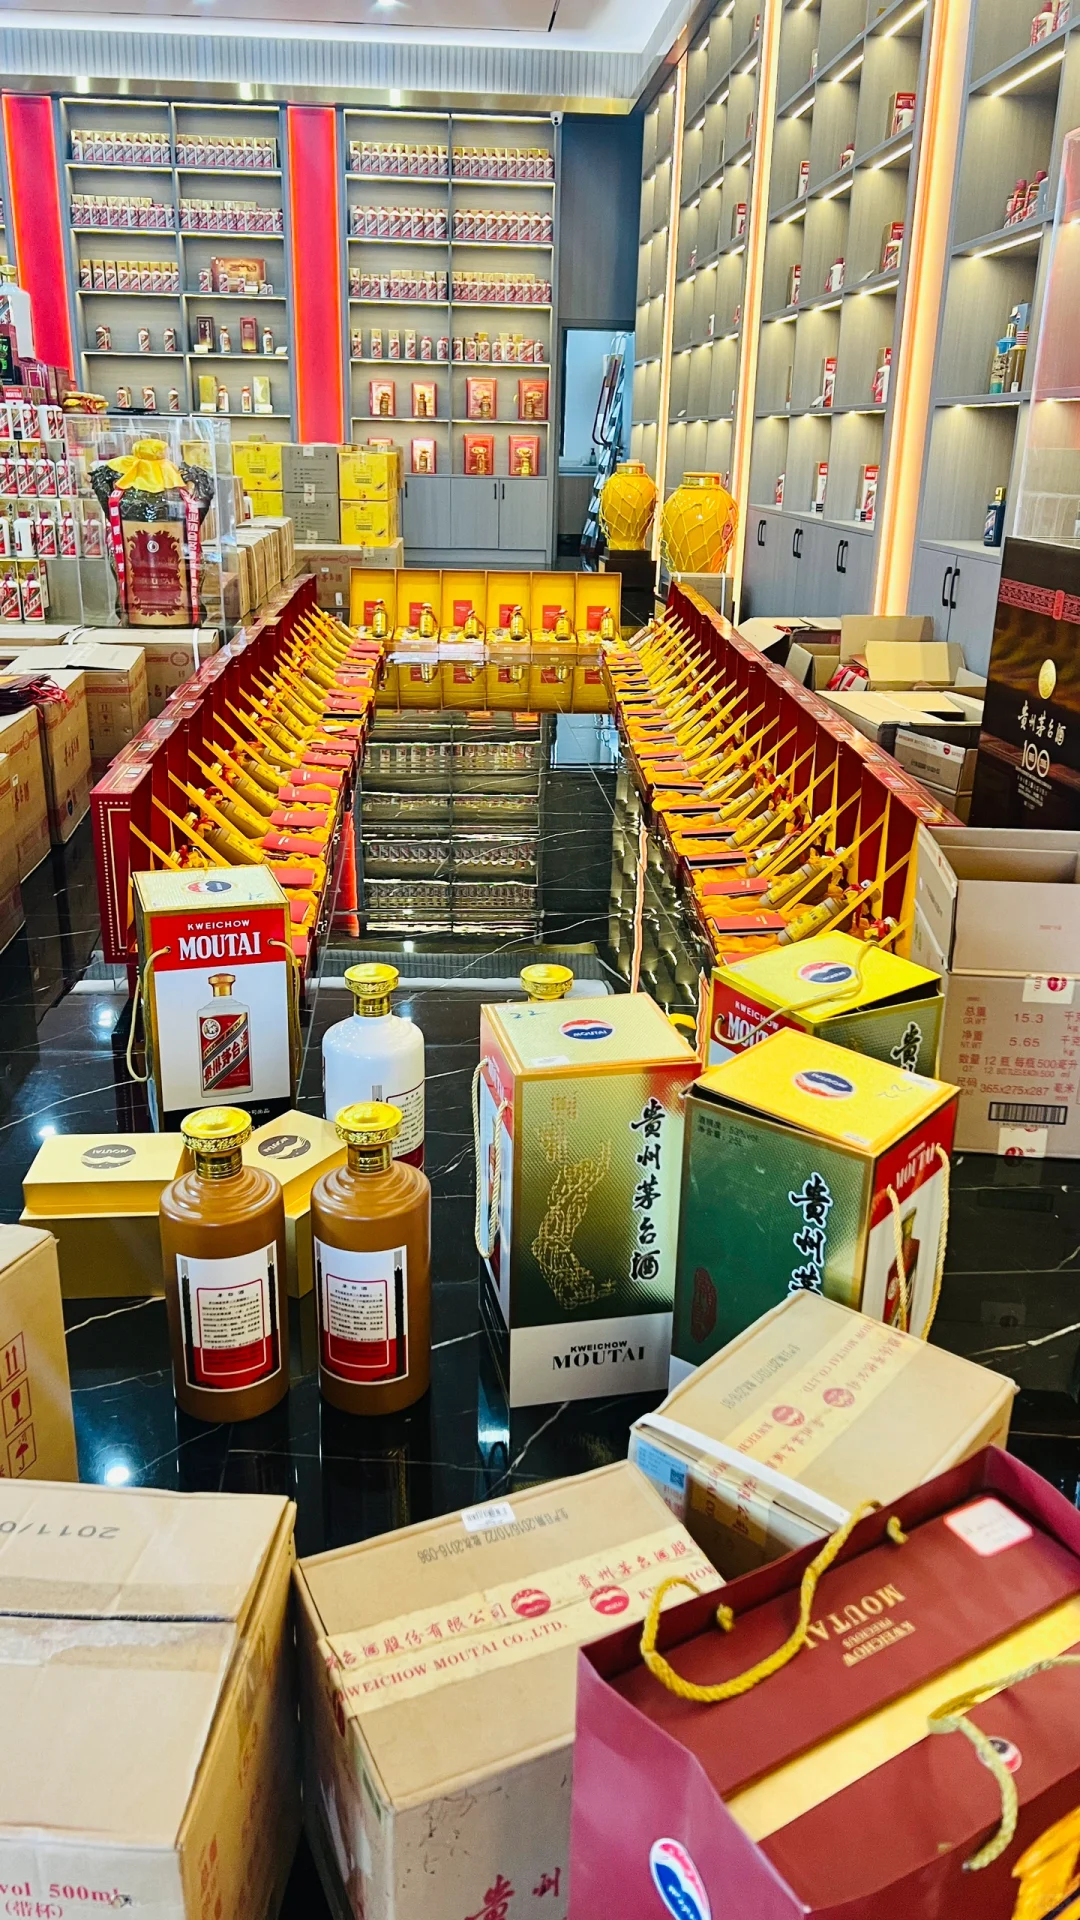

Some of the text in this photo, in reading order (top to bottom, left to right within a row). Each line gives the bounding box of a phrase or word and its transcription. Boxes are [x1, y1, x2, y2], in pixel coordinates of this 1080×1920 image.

[1021, 740, 1050, 778] 100
[187, 919, 250, 931] KWEICHOW
[178, 931, 262, 961] MOUTAI
[1014, 1013, 1044, 1024] 15.3
[572, 1029, 609, 1038] MOUTAI
[727, 1011, 771, 1048] MOUT
[1009, 1037, 1040, 1048] 5.65
[984, 1056, 997, 1066] 12
[980, 1082, 1050, 1097] 365x275x287
[570, 1340, 628, 1353] KWEICHOW
[553, 1346, 645, 1370] MOUTAI
[804, 1583, 907, 1650] MOUTAI
[433, 1641, 500, 1672] MOUTAI
[502, 1619, 568, 1648] CO.,LTD.
[842, 1620, 917, 1668] KWEICHOW
